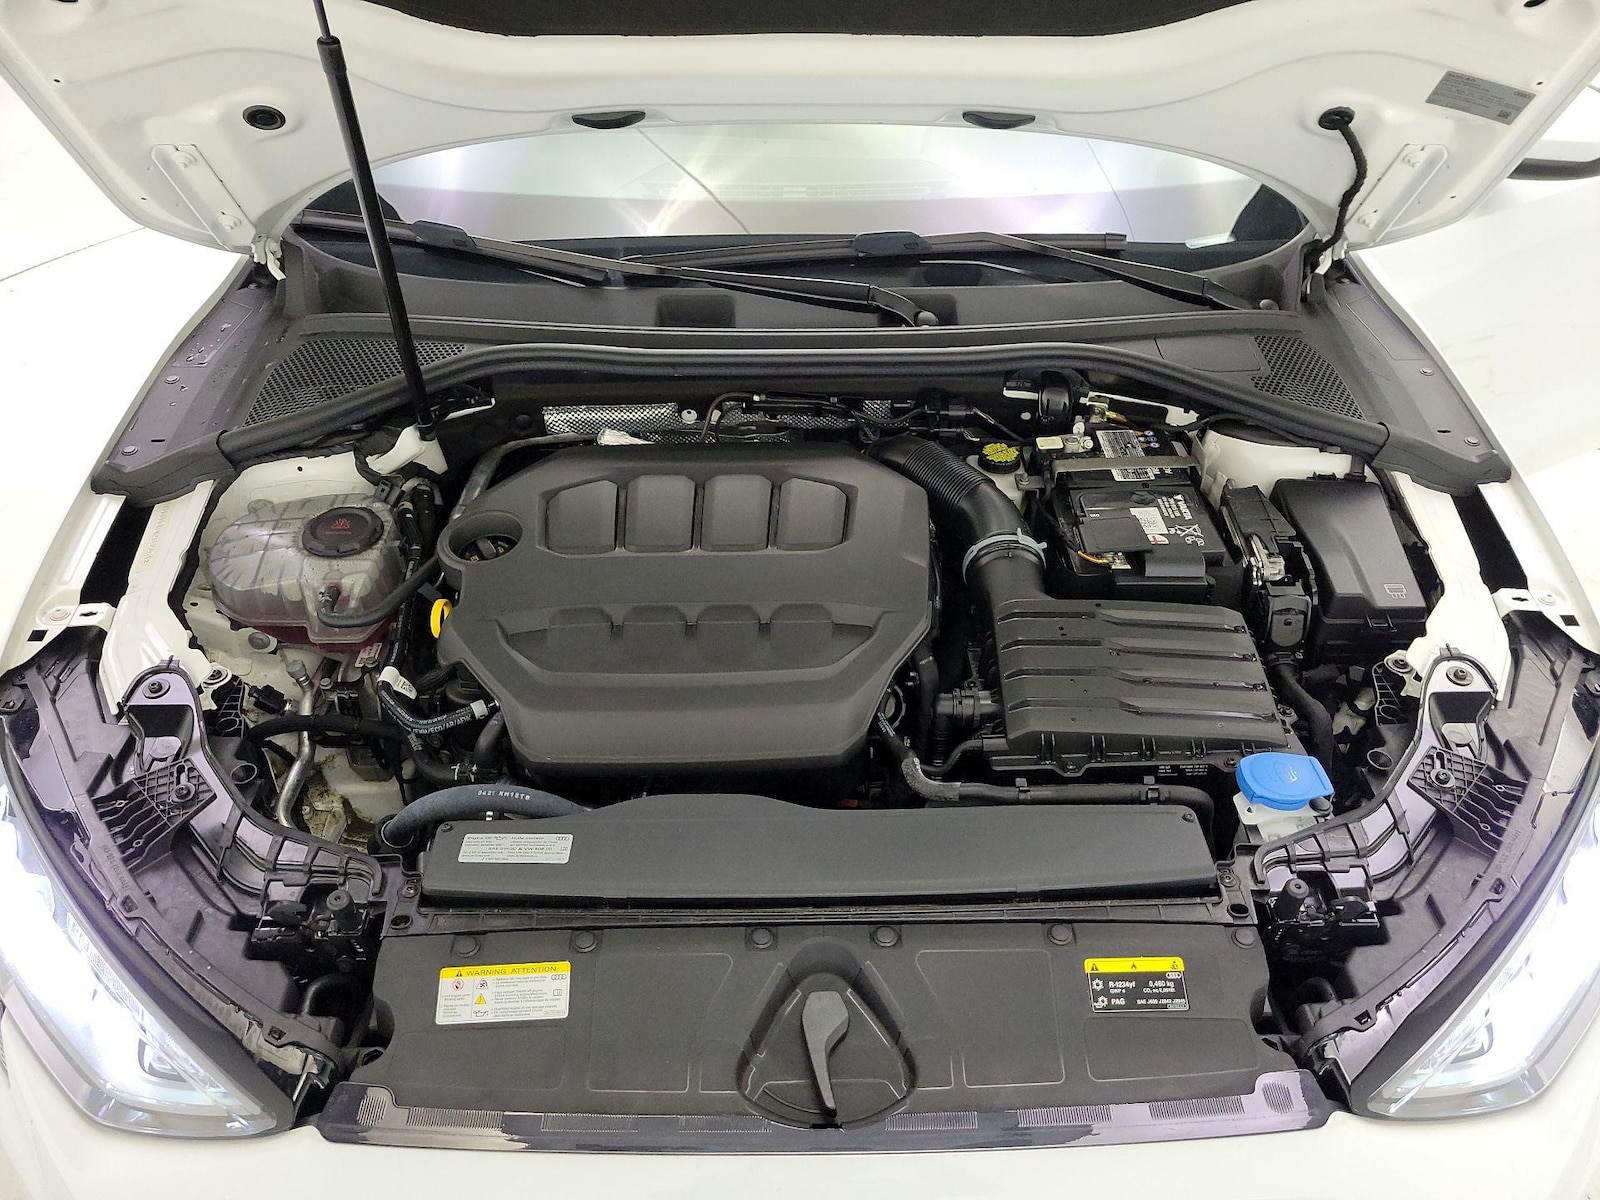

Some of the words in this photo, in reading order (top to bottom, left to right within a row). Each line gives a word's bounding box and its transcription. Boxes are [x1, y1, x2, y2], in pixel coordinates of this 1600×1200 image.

[466, 968, 507, 976] WARNING
[511, 966, 557, 974] ATTENTION
[1108, 980, 1136, 989] R-1234yf
